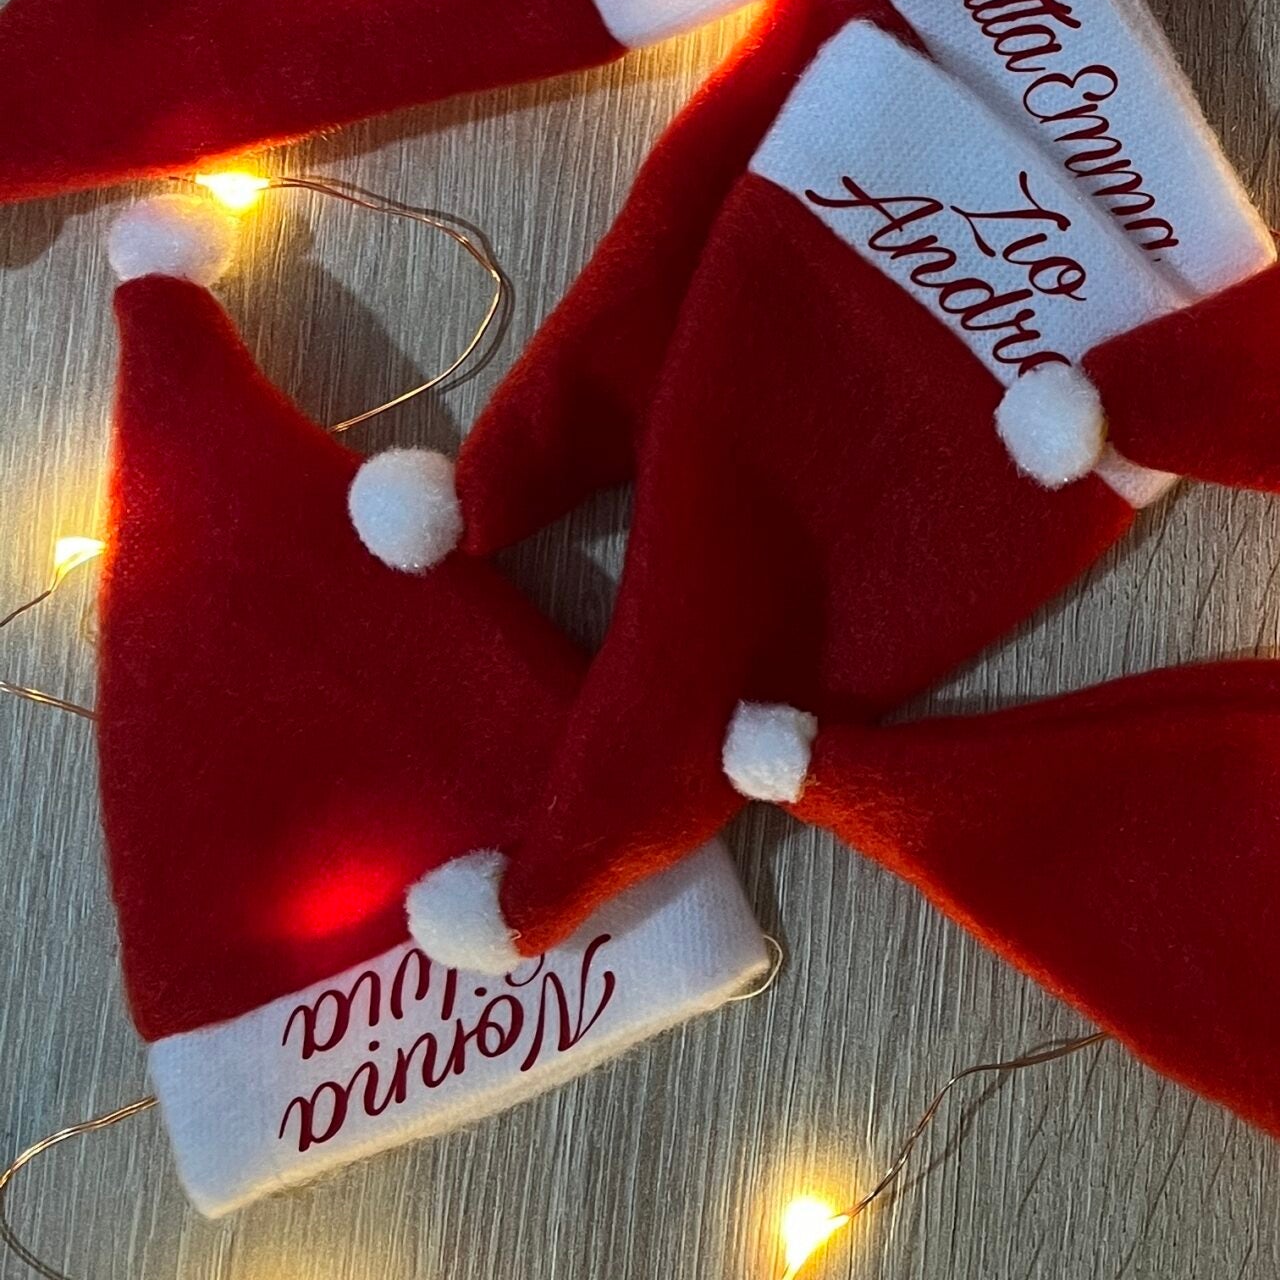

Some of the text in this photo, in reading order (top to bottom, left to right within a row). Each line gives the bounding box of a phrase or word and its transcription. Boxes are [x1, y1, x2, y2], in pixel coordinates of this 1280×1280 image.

[804, 175, 1073, 378] Andr
[949, 170, 1087, 302] Zio
[278, 933, 616, 1153] Nonna
[281, 948, 544, 1061] lvia
